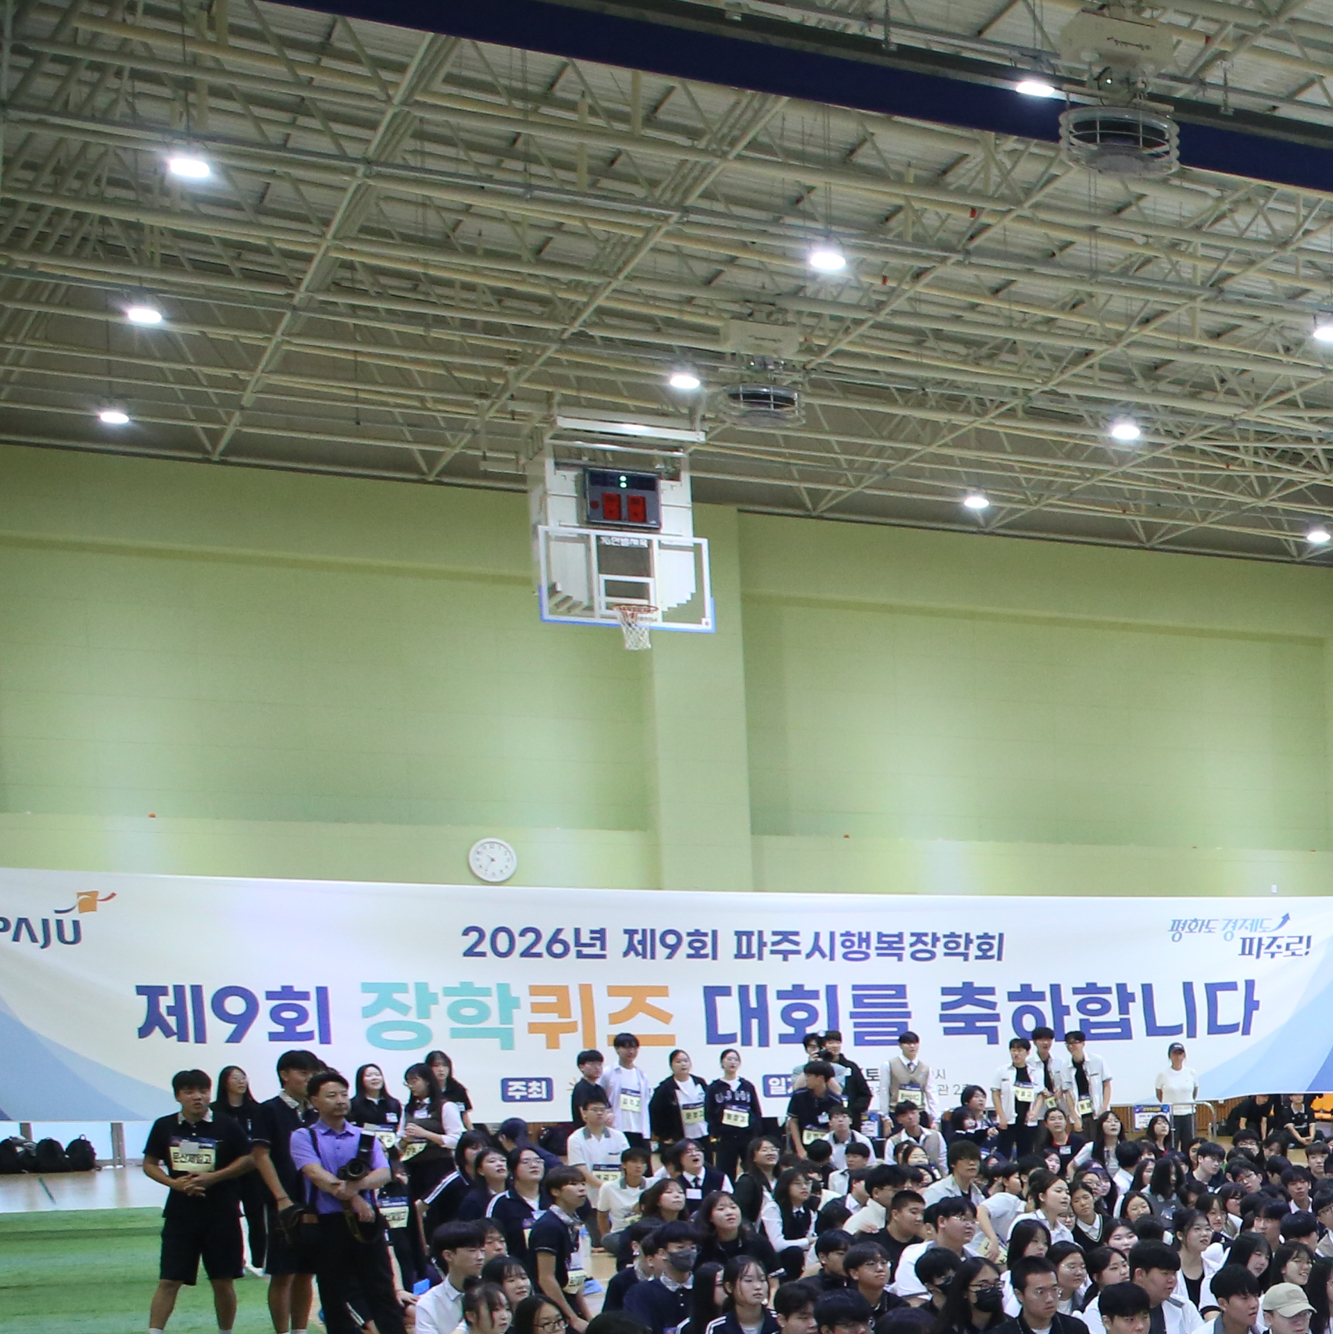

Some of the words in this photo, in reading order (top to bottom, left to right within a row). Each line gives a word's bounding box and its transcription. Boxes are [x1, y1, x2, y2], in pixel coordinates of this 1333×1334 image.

[461, 926, 608, 960] 2026년
[622, 928, 719, 961] 제9회
[734, 930, 1005, 962] 파주시행복장학회
[1238, 934, 1312, 960] 파주로!
[134, 984, 332, 1045] 제9회
[361, 982, 677, 1051] 장학퀴즈
[702, 983, 912, 1049] 대회를
[938, 979, 1260, 1047] 축하합니다
[507, 1080, 548, 1101] 주최
